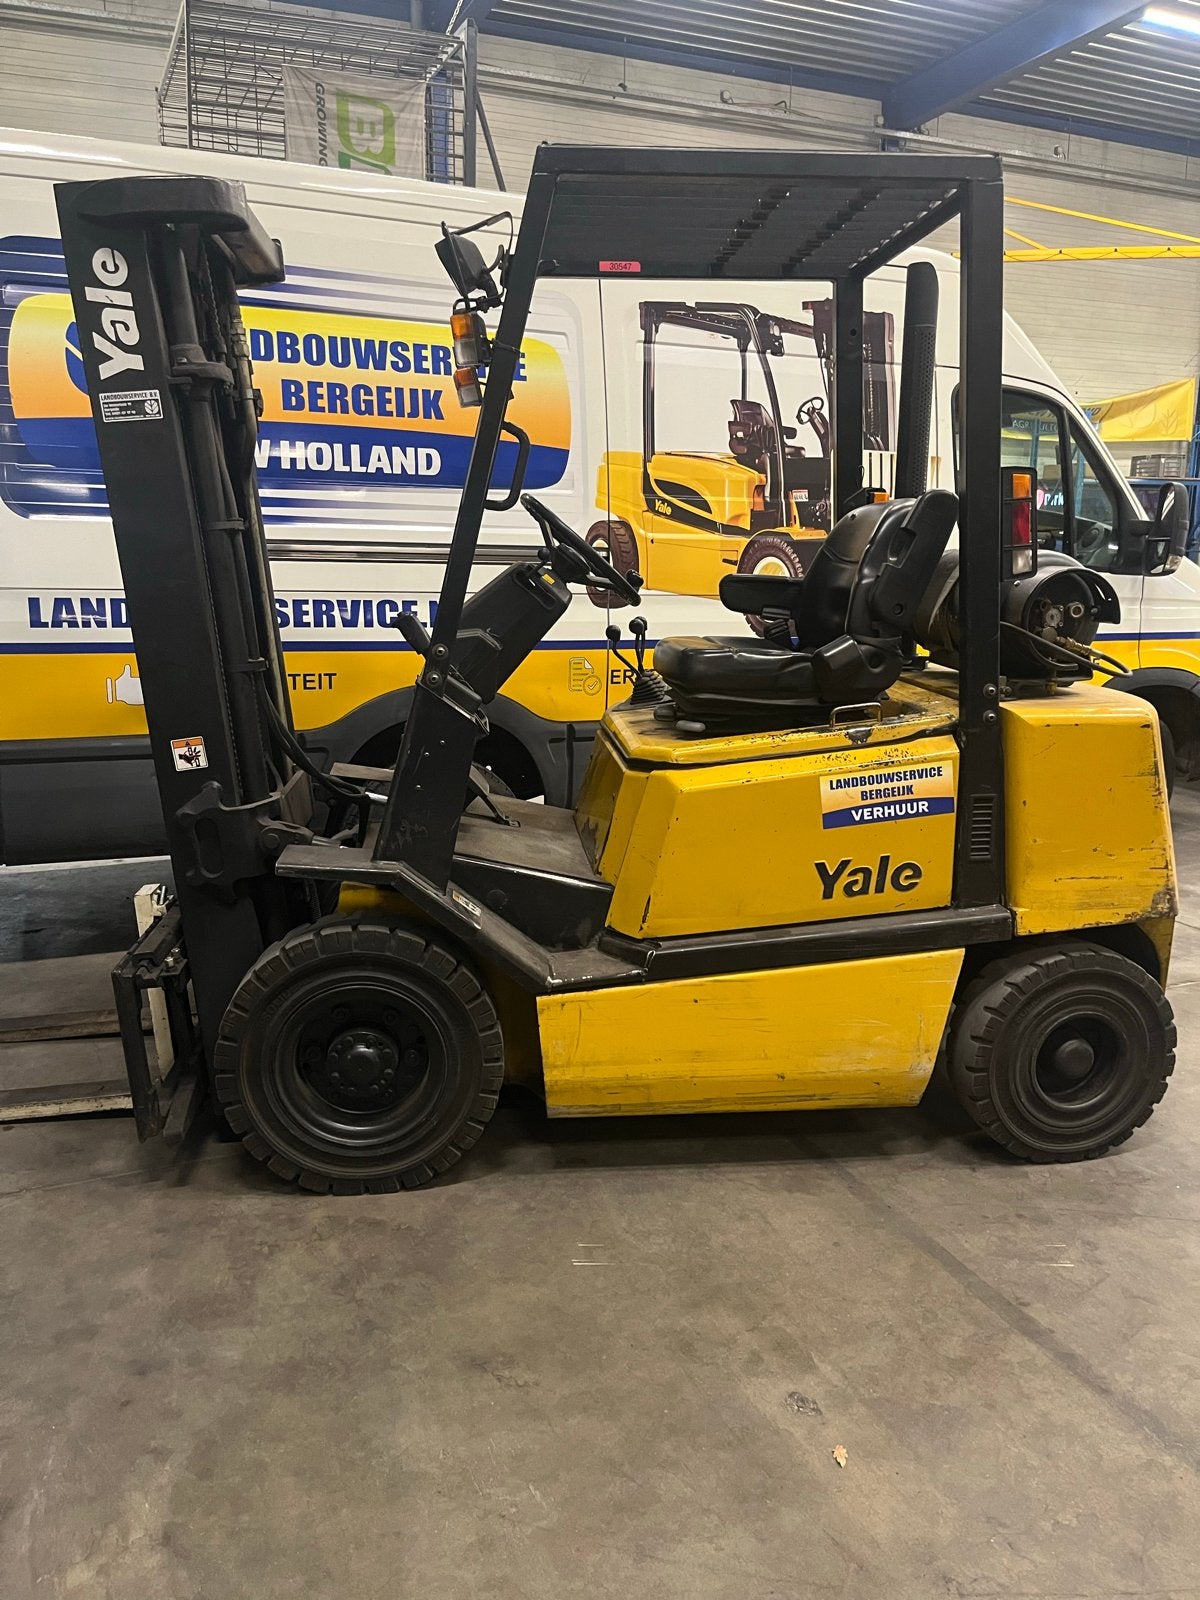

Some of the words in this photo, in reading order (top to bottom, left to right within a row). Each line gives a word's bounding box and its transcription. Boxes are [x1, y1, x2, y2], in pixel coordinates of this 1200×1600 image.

[315, 82, 328, 167] GROWING
[609, 262, 632, 271] 30547
[84, 247, 145, 380] Yale
[250, 328, 527, 382] DBOUWSERE
[101, 392, 147, 401] LANDBOUWSERVICE
[281, 378, 445, 420] BERGEIJK
[279, 440, 442, 476] HOLLAND
[654, 498, 672, 516] Yale
[829, 766, 943, 791] LANDBOUWSERVICE
[860, 784, 914, 802] BERGEIJK
[851, 801, 930, 822] VERHUUR
[814, 854, 922, 900] Yale
